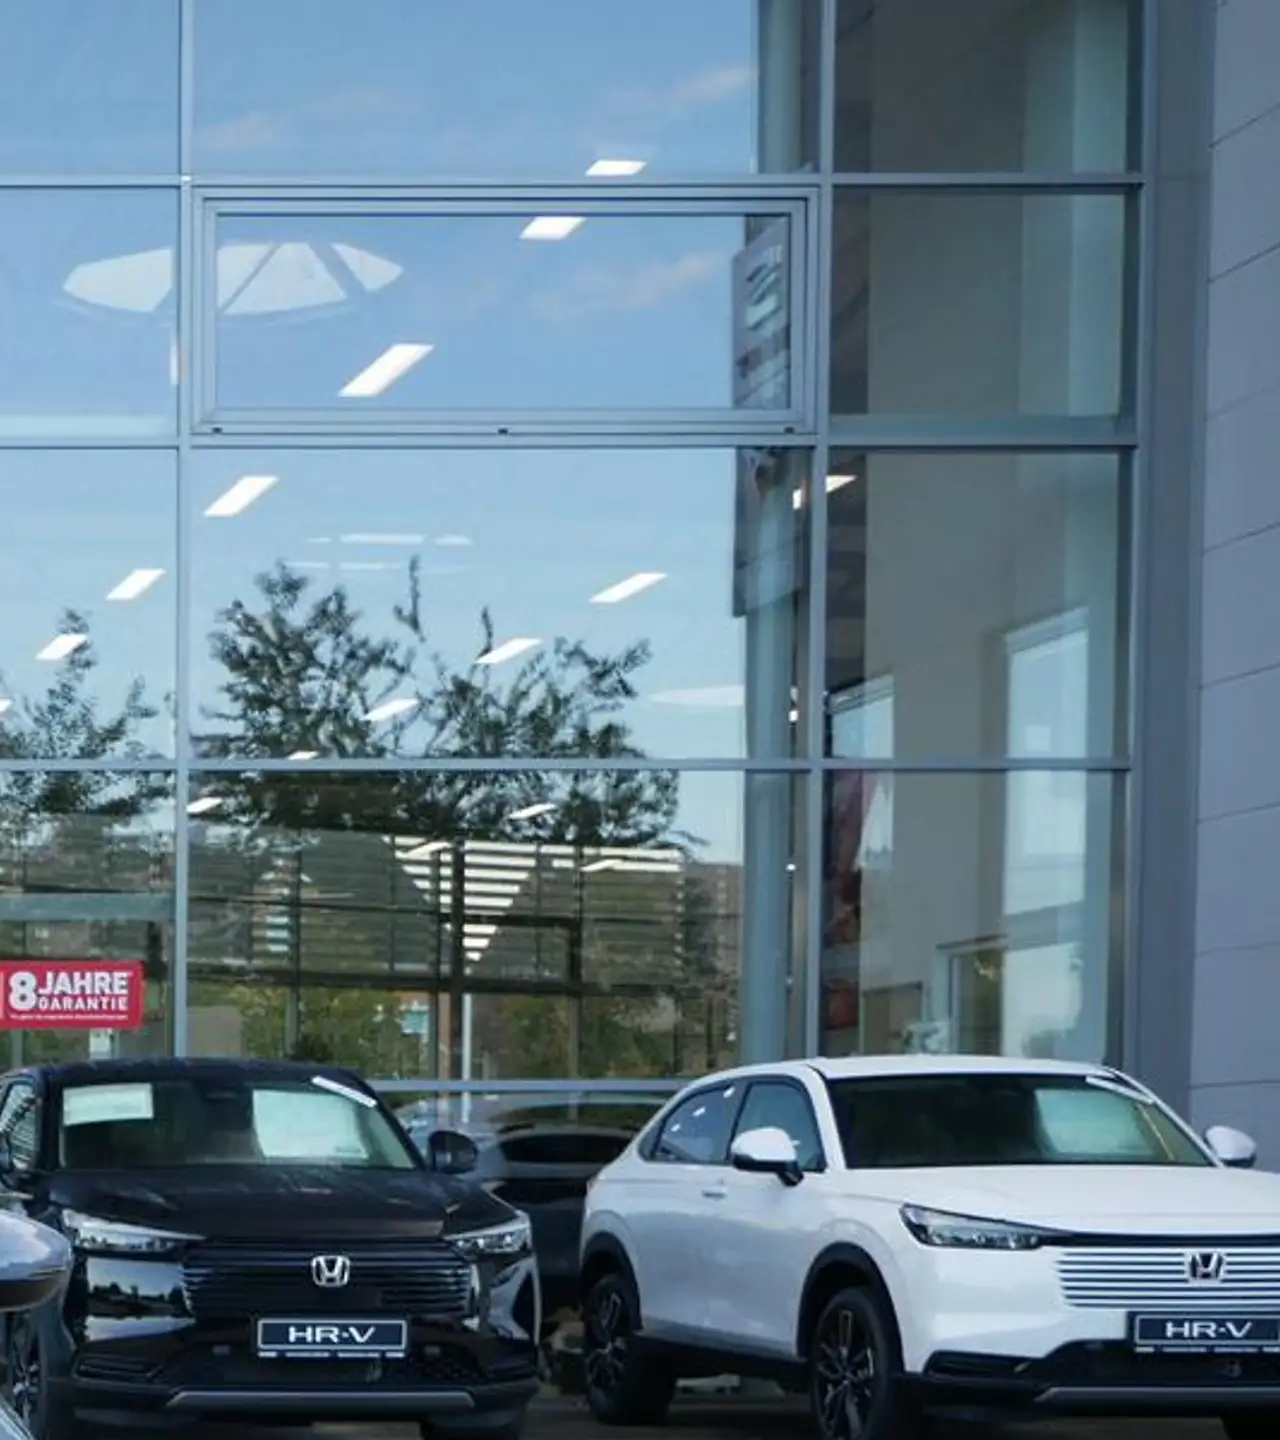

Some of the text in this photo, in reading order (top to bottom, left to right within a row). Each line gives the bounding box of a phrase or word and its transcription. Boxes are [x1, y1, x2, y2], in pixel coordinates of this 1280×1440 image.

[8, 971, 38, 1012] 8
[39, 996, 129, 1012] GARANTIE
[288, 1326, 376, 1343] HR-V
[1165, 1321, 1253, 1338] HR-V
